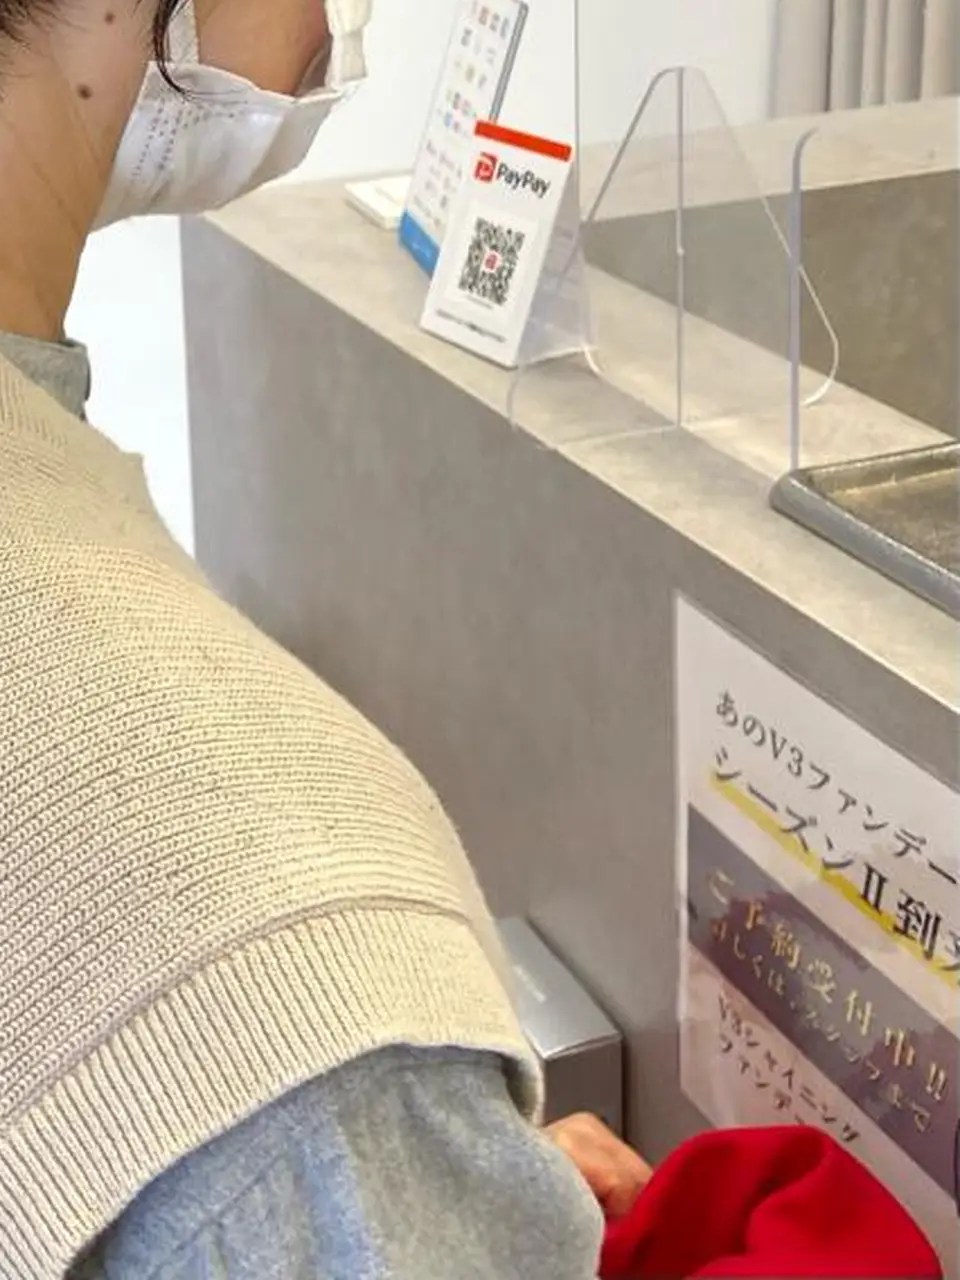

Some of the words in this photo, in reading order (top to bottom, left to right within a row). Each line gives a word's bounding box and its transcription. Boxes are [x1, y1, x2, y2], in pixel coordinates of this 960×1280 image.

[496, 162, 551, 199] PayPay
[716, 690, 958, 885] あのV3ファンデー
